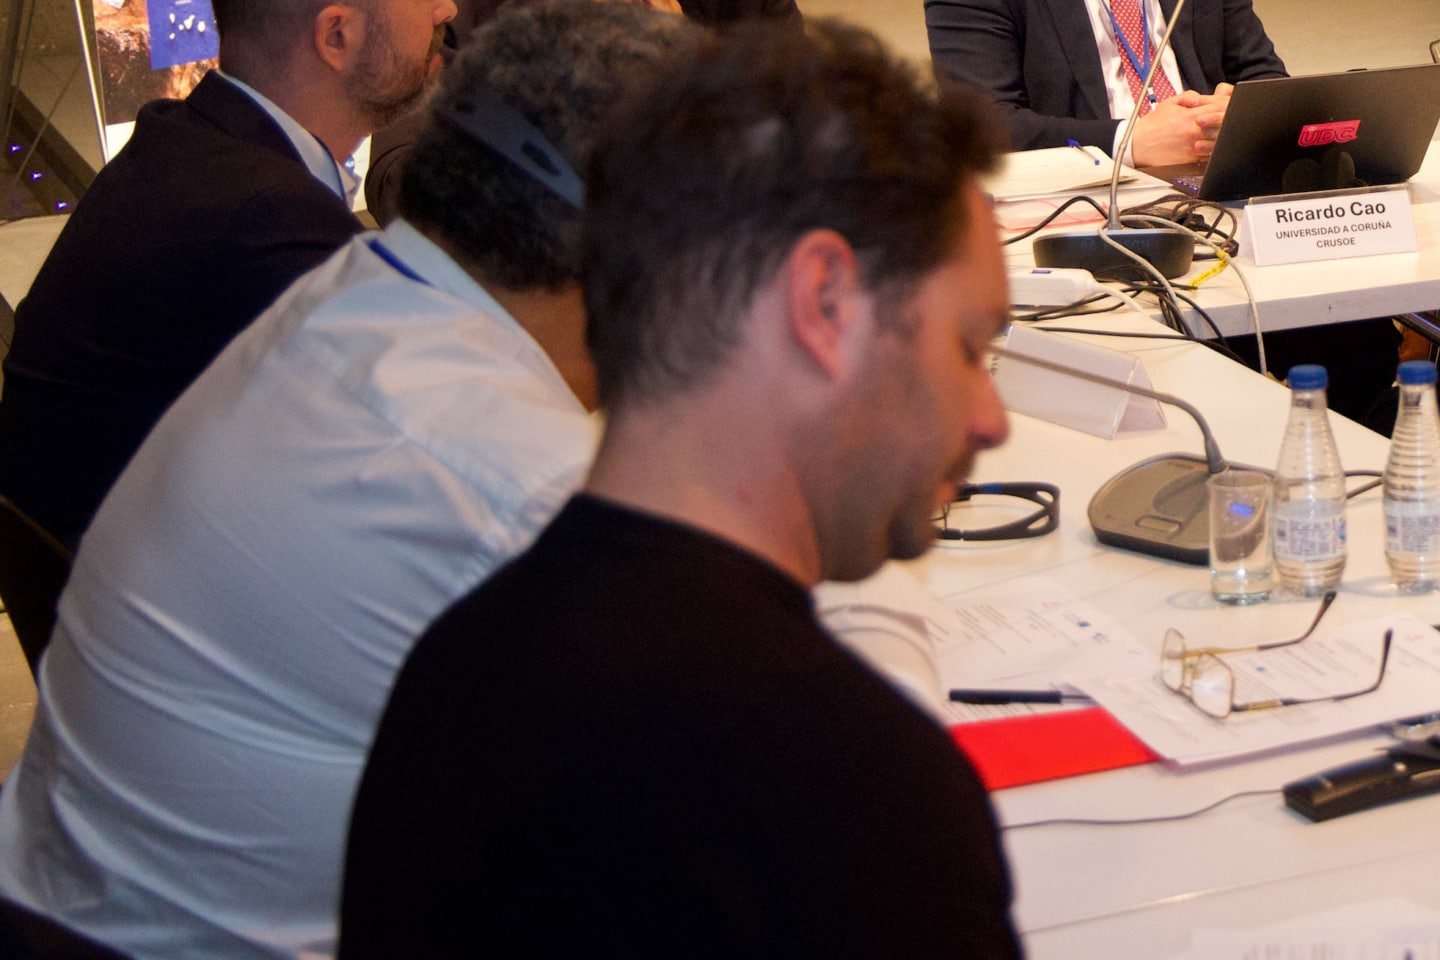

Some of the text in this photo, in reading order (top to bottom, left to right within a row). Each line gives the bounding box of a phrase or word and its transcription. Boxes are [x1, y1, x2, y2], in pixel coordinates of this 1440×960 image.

[1300, 127, 1357, 146] UDC
[1275, 201, 1386, 224] Ricardo Cao
[1275, 220, 1392, 240] UNIVERSIDAD A CORUÑA
[1316, 236, 1356, 249] CRUSOE
